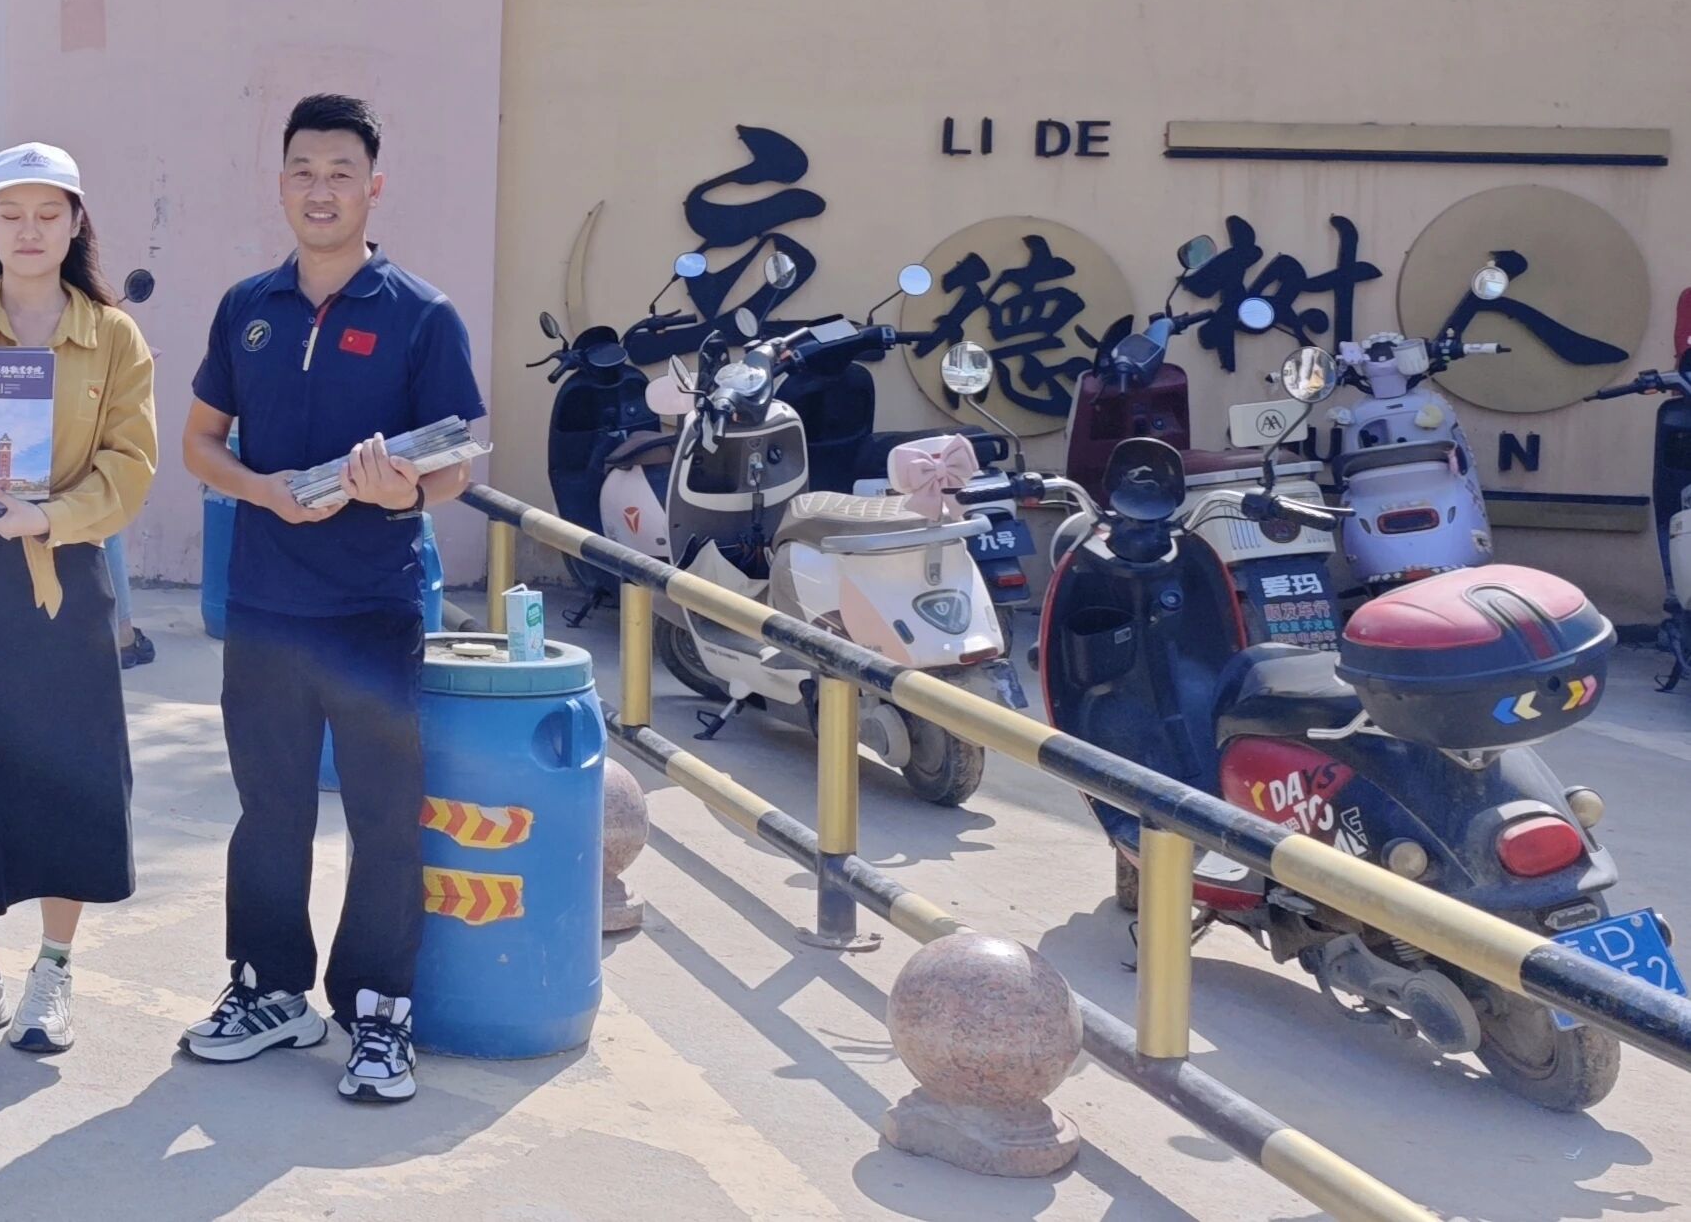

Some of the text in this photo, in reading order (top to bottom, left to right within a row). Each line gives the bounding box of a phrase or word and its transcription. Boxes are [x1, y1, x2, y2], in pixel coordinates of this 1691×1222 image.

[942, 116, 1111, 157] LI DE
[977, 530, 1017, 552] 九号
[1260, 572, 1324, 598] 爱玛
